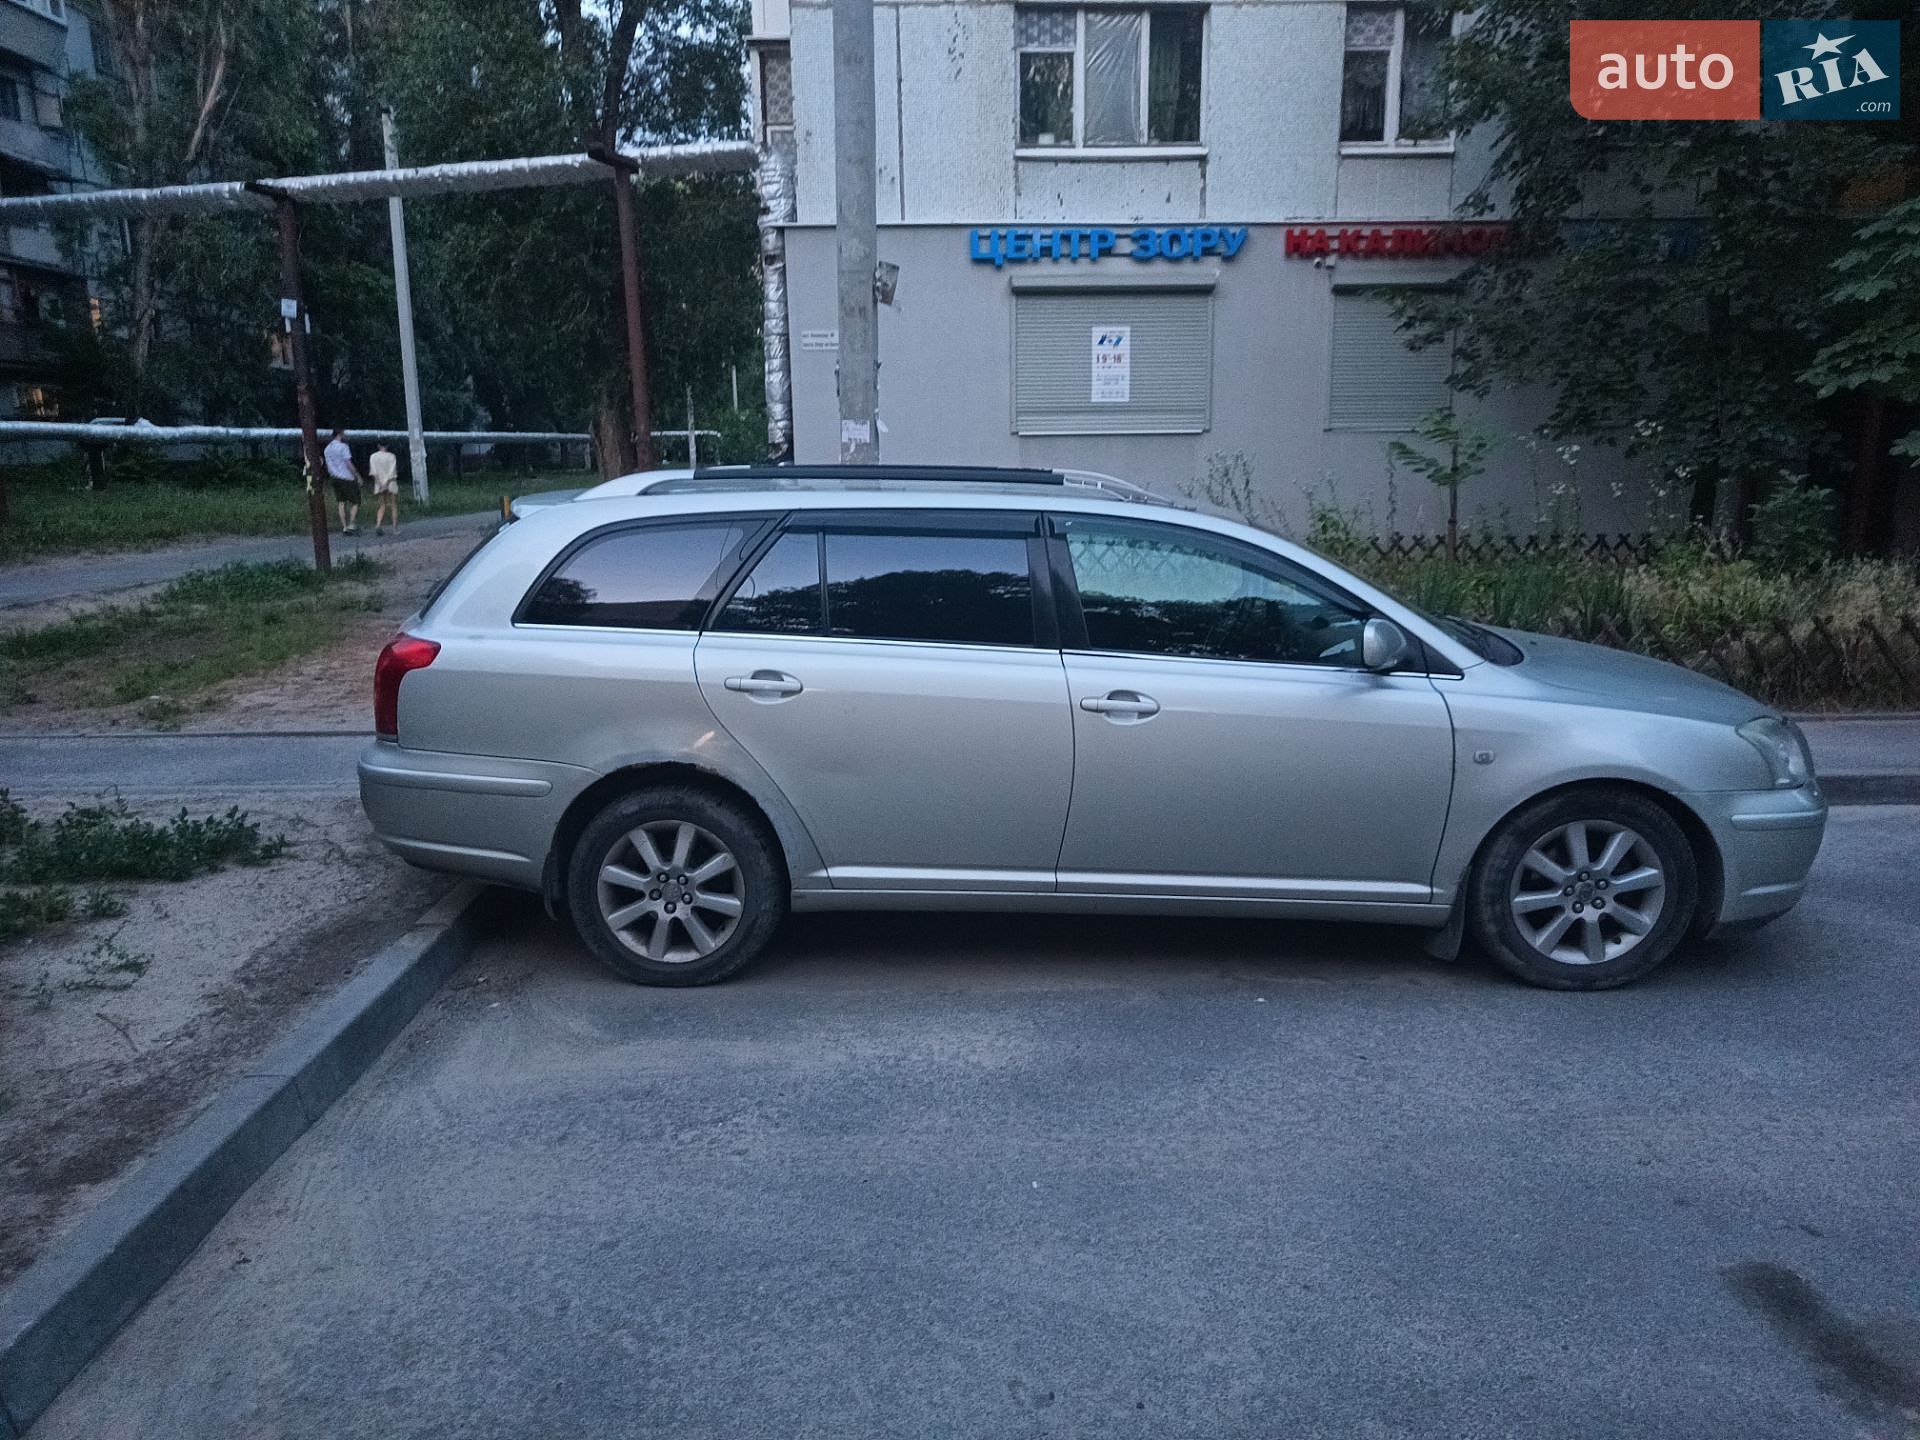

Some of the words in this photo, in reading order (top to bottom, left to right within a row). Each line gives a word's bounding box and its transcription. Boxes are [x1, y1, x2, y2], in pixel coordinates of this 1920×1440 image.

[970, 229, 1116, 266] ЦЕНТР
[1129, 228, 1249, 263] ЗОРУ
[1285, 229, 1329, 255] НА
